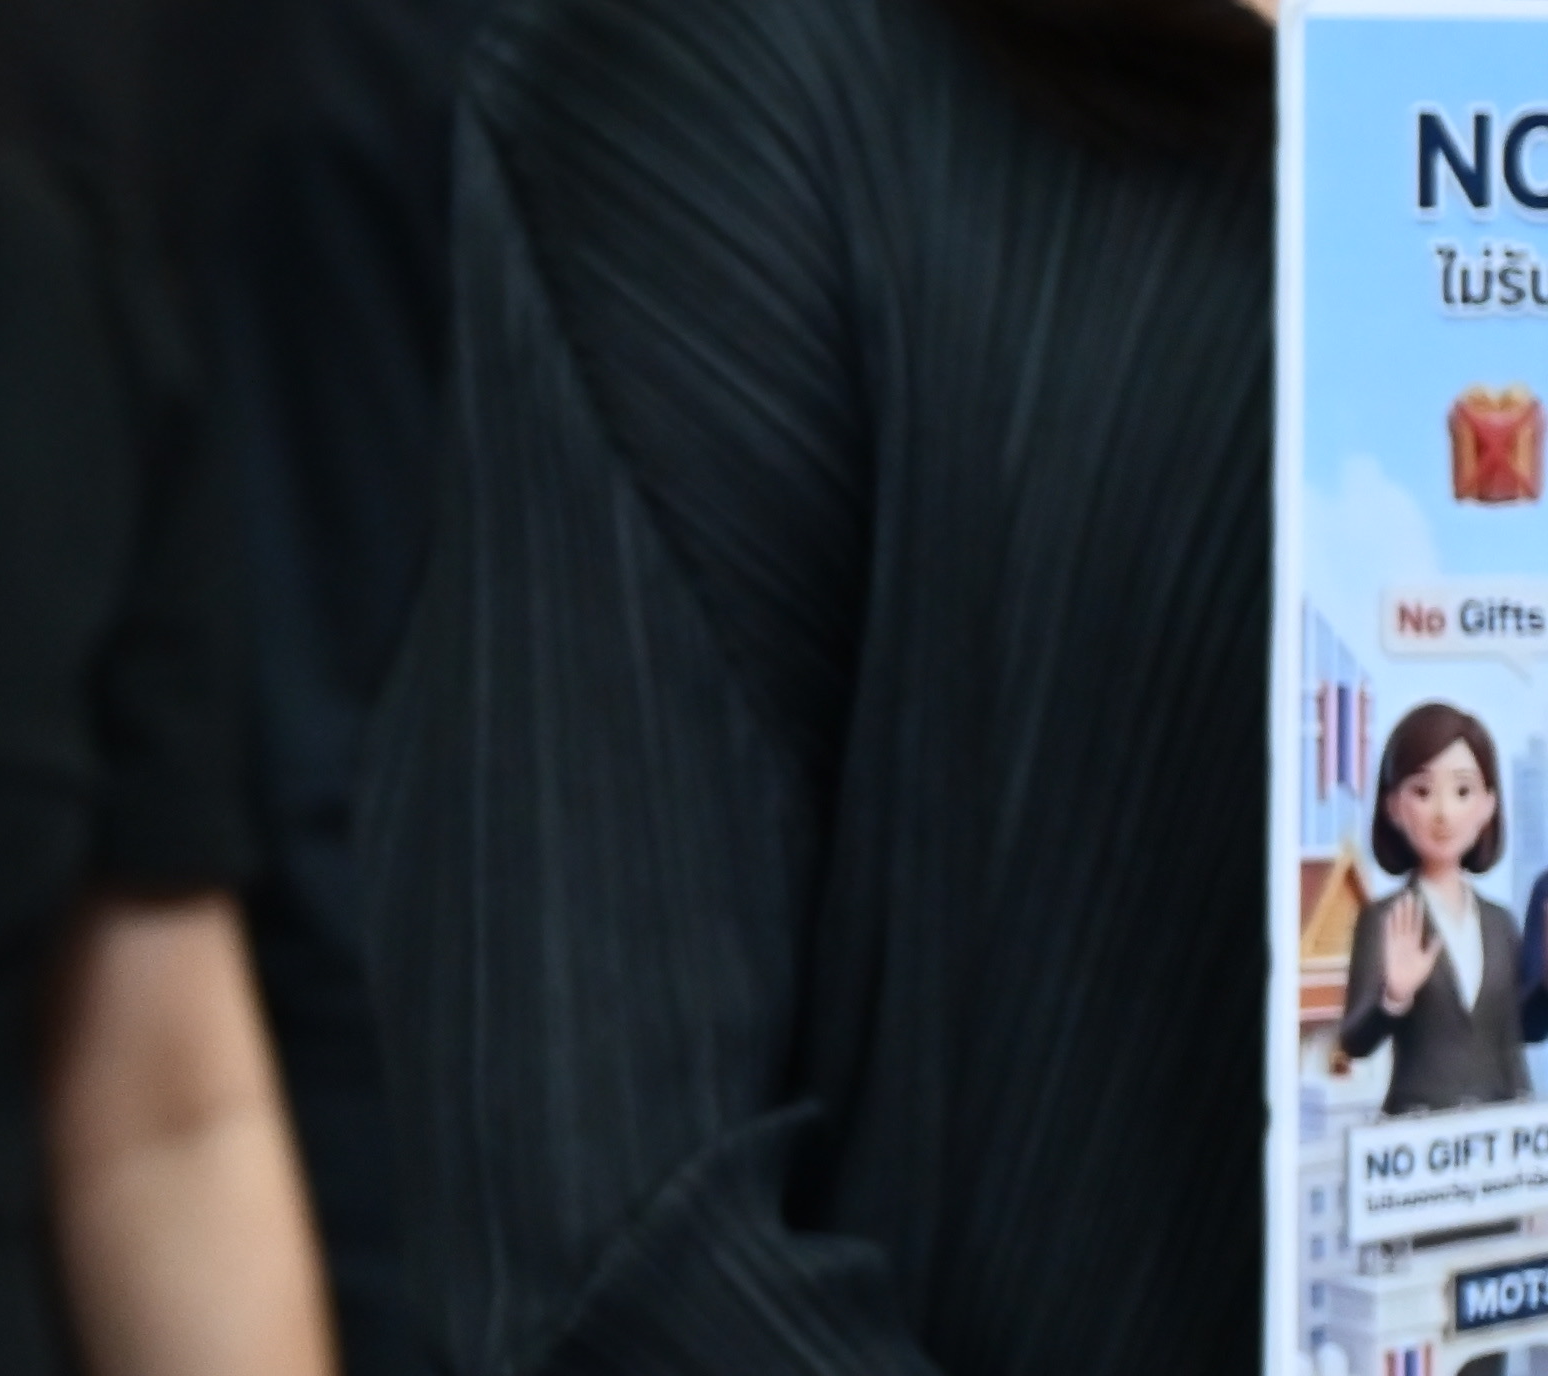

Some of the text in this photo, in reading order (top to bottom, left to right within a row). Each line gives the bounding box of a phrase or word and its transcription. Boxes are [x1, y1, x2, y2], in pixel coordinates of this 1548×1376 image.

[1397, 597, 1546, 637] No Gifts
[1366, 1144, 1414, 1178] NO
[1428, 1131, 1498, 1171] GIFT
[1465, 1269, 1548, 1322] MOT
